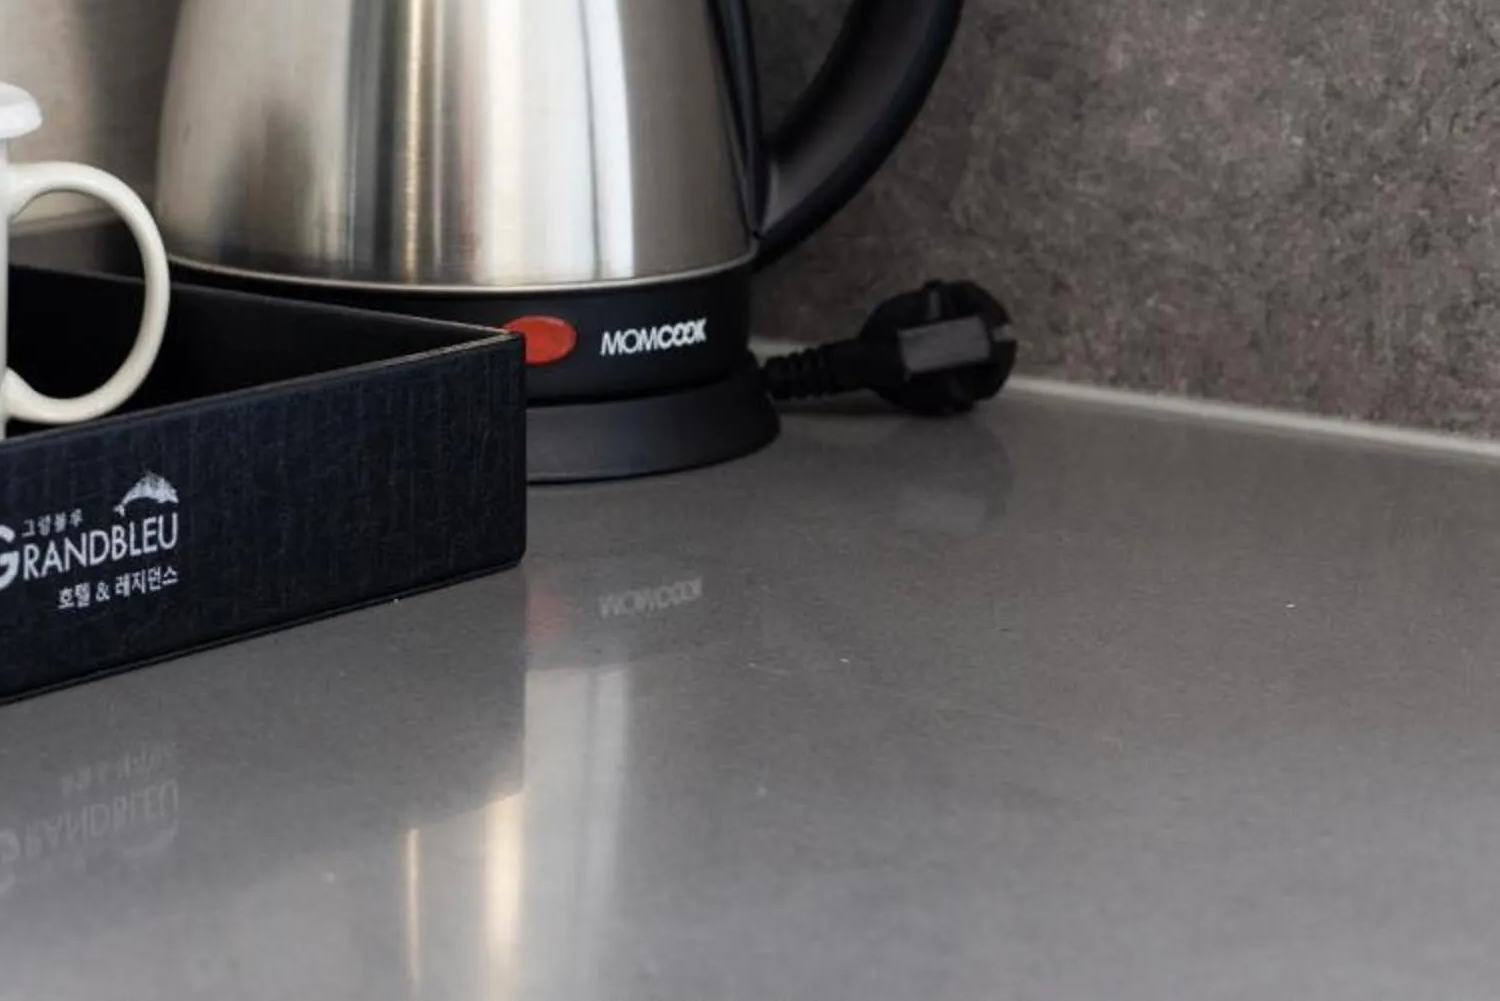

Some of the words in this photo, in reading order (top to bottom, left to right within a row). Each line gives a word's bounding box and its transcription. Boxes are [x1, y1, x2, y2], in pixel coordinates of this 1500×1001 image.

[600, 318, 707, 356] MOMCOOK
[58, 582, 90, 609] 호텔
[96, 583, 110, 602] &
[115, 566, 179, 597] 레지던스
